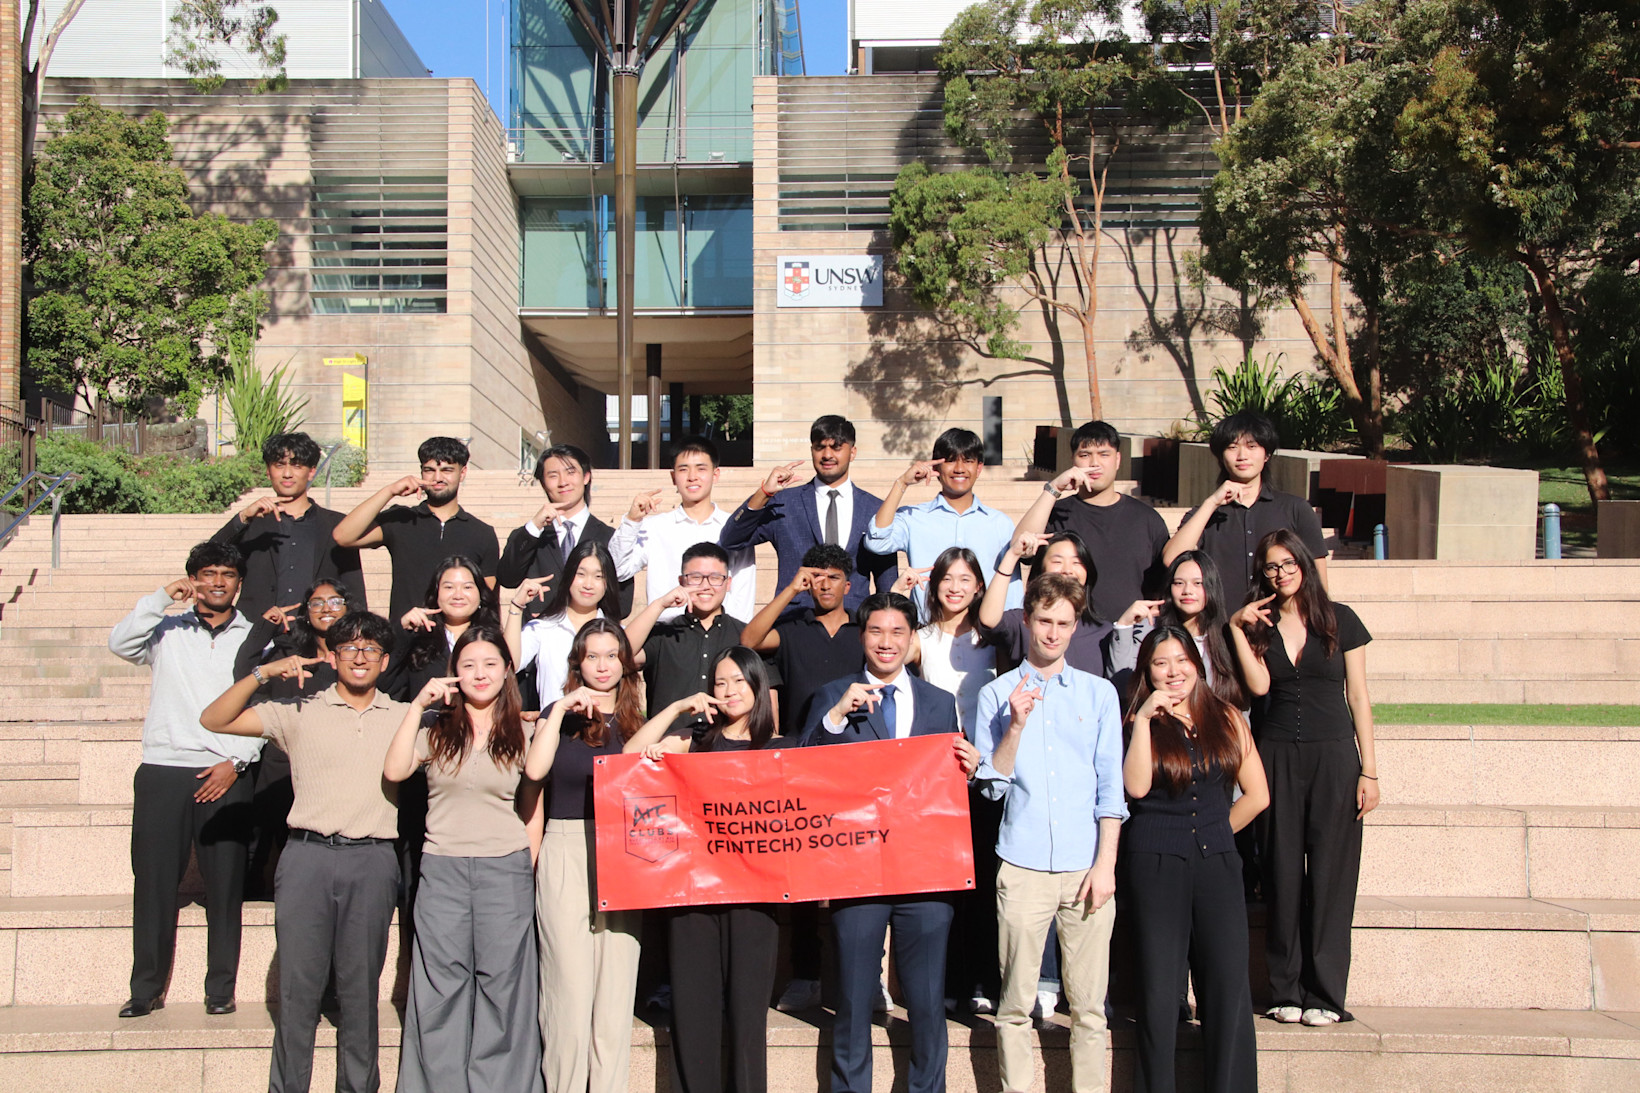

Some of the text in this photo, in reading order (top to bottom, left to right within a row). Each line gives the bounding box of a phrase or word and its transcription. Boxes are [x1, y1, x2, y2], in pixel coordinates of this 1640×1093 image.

[815, 267, 877, 285] UNSW
[703, 797, 807, 816] FINANCIAL
[629, 828, 673, 837] CLUBS
[705, 813, 834, 835] TECHNOLOGY
[707, 828, 890, 855] (FINTECH) SOCIETY
